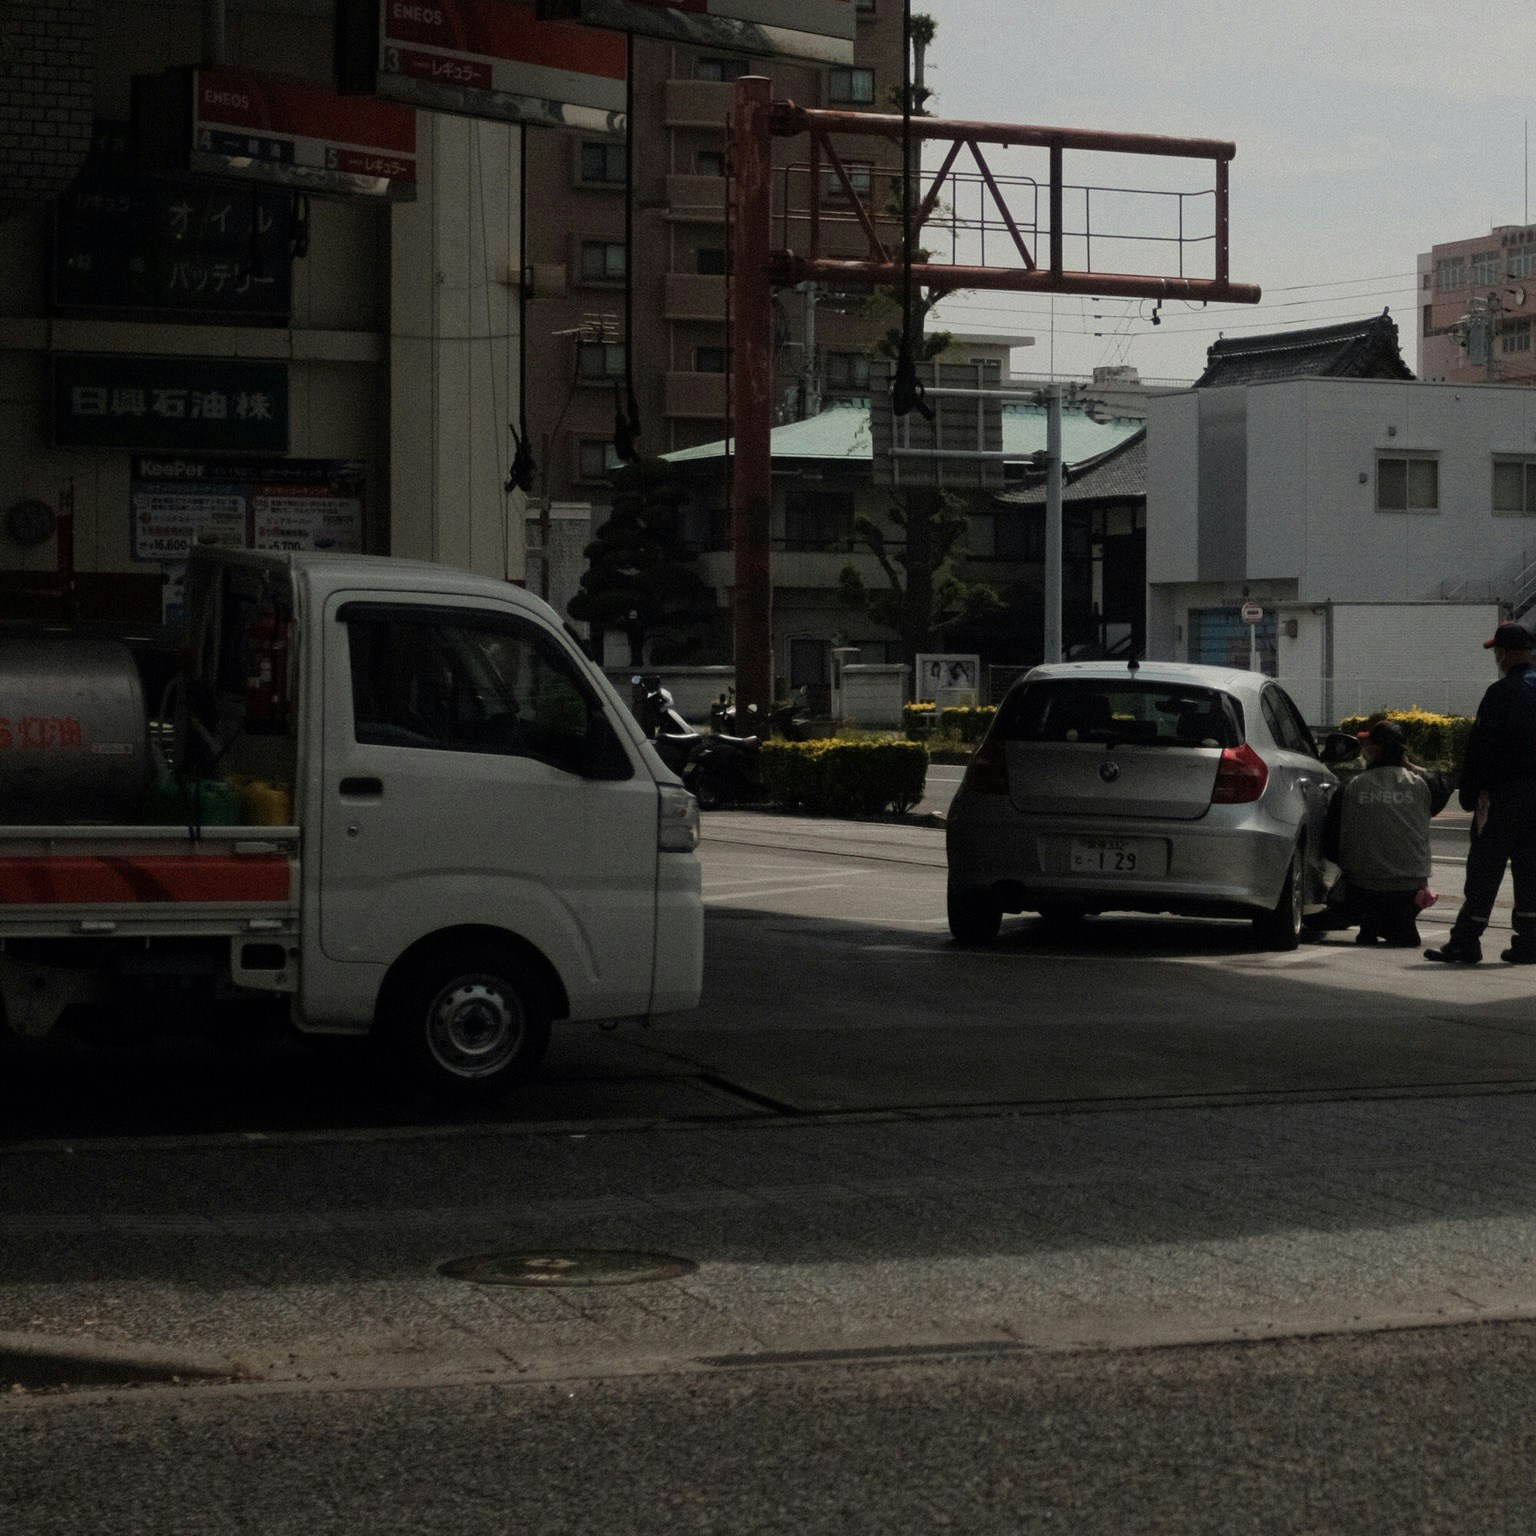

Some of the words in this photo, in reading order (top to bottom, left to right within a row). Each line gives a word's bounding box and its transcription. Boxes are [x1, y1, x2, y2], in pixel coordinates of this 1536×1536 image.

[393, 2, 443, 26] ENEOS
[388, 49, 399, 73] 3
[431, 59, 482, 81] レギュラー
[204, 90, 249, 109] ENEOS
[364, 157, 407, 175] レギュラー
[168, 201, 274, 234] オイル
[168, 261, 275, 294] バッテリー
[139, 460, 205, 477] KeePer
[1358, 791, 1414, 805] ENEOS
